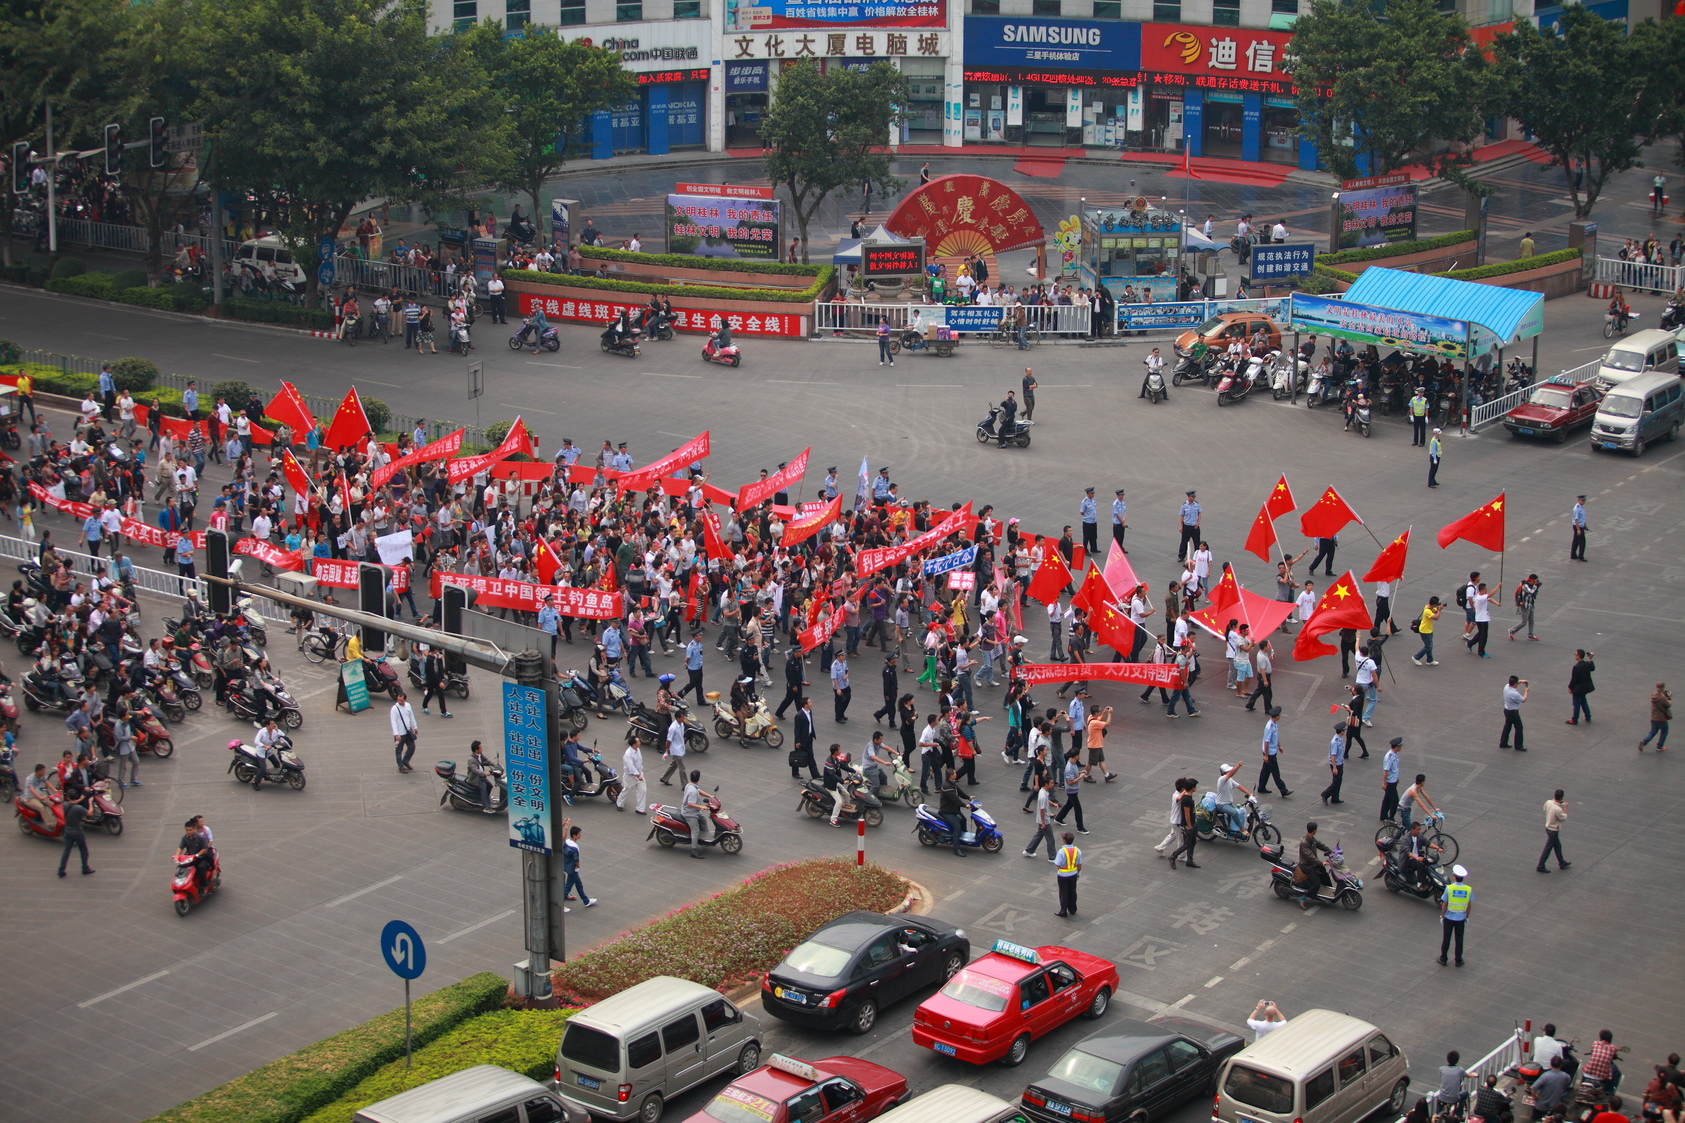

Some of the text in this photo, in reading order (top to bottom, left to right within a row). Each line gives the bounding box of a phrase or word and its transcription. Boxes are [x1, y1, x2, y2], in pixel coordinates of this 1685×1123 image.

[785, 6, 939, 18] 百姓省钱集中赢 价格解放全桂林
[602, 37, 640, 51] China
[1003, 25, 1101, 46] SAMSUNG
[650, 47, 698, 60] 中国联通
[734, 32, 940, 58] 文化大厦电脑城
[1025, 51, 1080, 61] 三星手机体验店
[1208, 36, 1300, 75] 迪信
[728, 65, 764, 76] 步步高
[1343, 194, 1414, 214] 文明桂林 我的责任
[674, 205, 774, 222] 文明桂林 我的责任
[1343, 211, 1412, 232] 桂林文明 我的光荣
[674, 223, 774, 241] 桂林文明 我的光荣
[1257, 250, 1310, 262] 规范执法行为
[1256, 262, 1309, 274] 创建和谐交通
[948, 318, 999, 326] 心情时时舒畅
[950, 309, 1000, 318] 驾车相互礼让
[315, 562, 342, 584] 勿忘国耻
[507, 688, 527, 808] 人让车 让出一份安全
[526, 690, 545, 812] 车让人 让出一份文明
